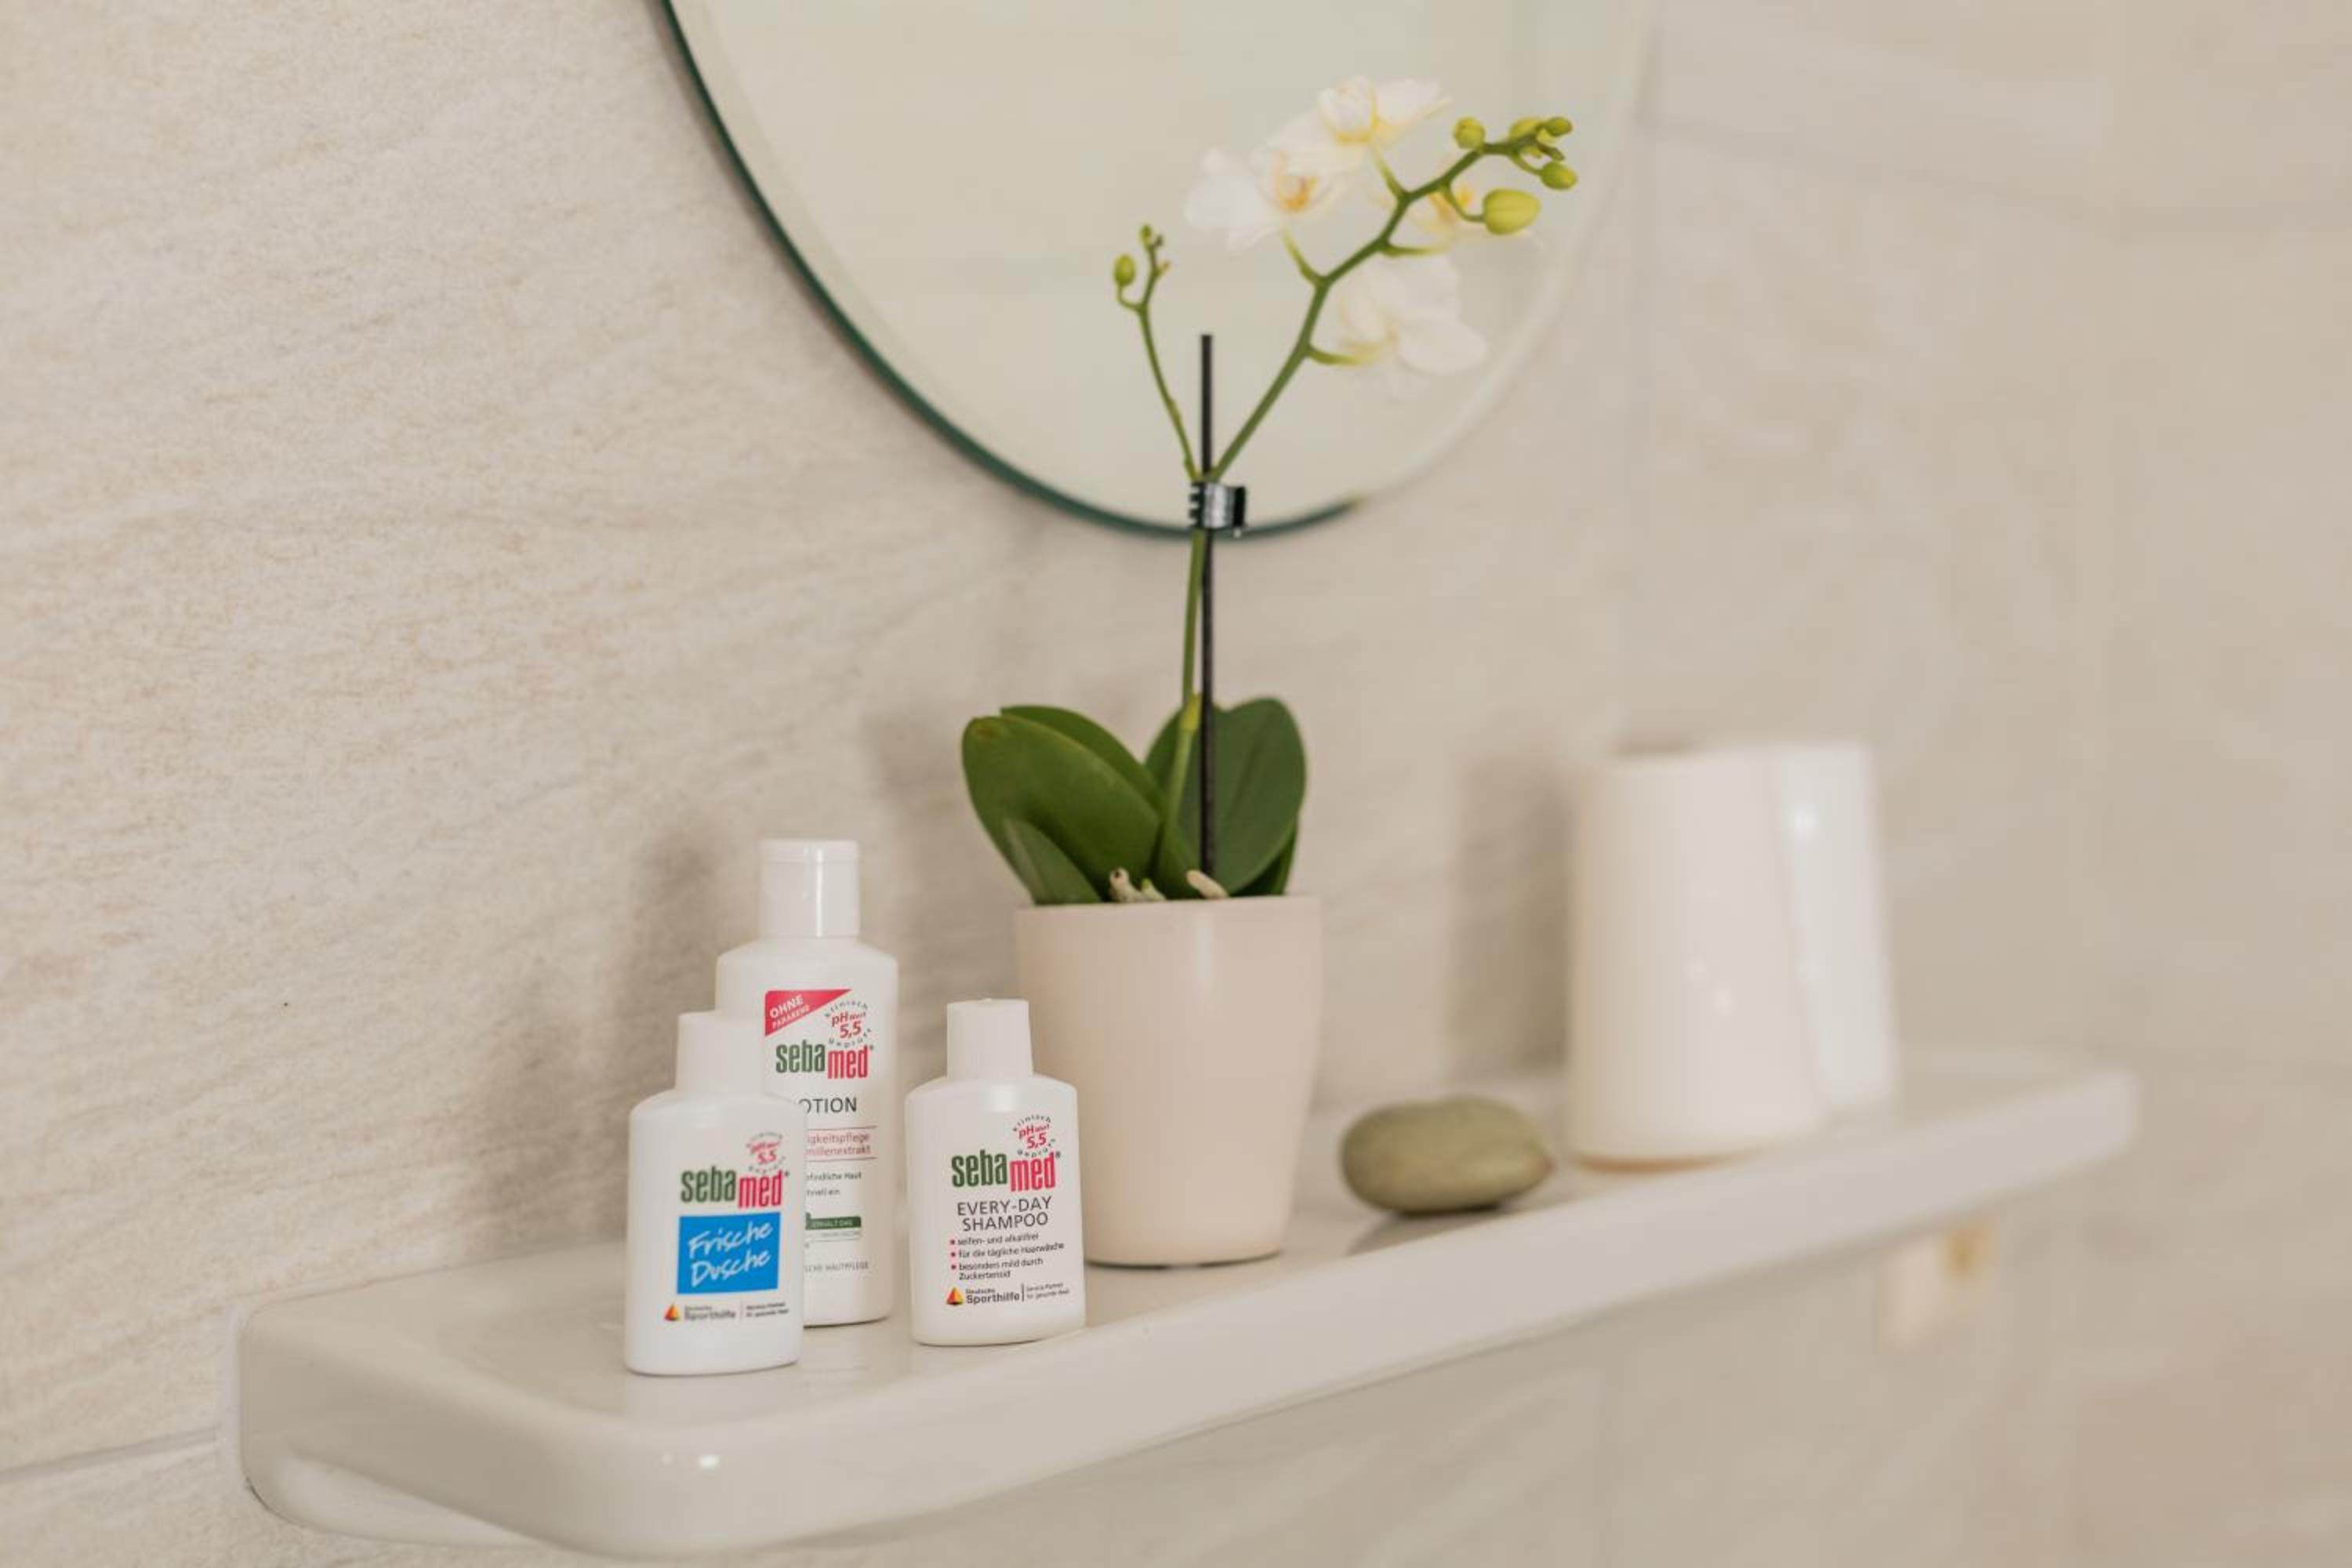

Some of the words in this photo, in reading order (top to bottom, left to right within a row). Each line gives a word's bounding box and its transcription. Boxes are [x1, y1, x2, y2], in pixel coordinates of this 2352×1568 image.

[769, 994, 804, 1018] OHNE
[832, 1011, 849, 1027] pH
[839, 1020, 862, 1039] 5,5
[798, 1097, 857, 1114] OTION
[1018, 1124, 1034, 1140] pH
[1026, 1132, 1047, 1149] 5,5
[956, 1196, 1052, 1216] EVERY-DAY
[962, 1211, 1049, 1232] SHAMPOO
[688, 1221, 774, 1259] Frische
[987, 1235, 1003, 1244] und
[691, 1247, 771, 1287] Dusche
[966, 1292, 1020, 1305] Sporthilfe
